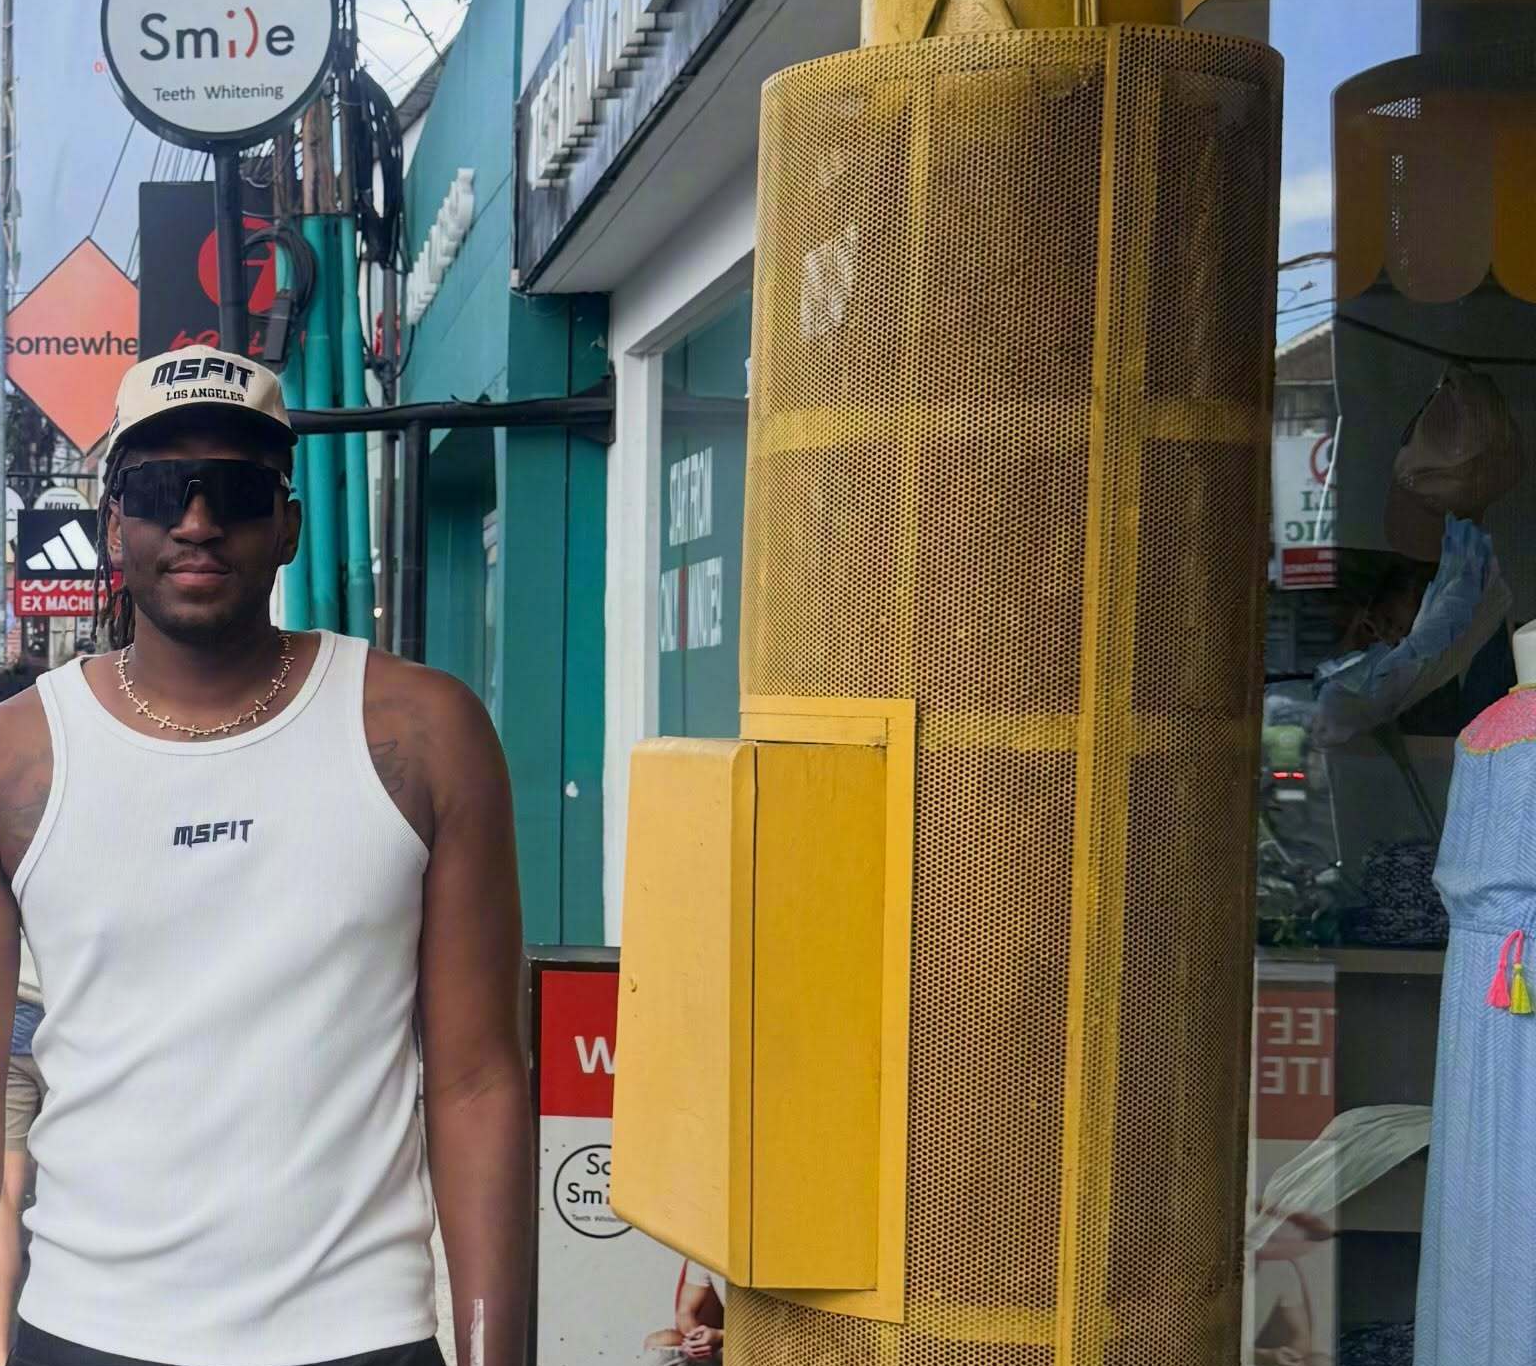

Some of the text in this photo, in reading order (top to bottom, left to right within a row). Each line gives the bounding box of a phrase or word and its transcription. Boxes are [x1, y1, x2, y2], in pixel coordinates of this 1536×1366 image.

[153, 82, 285, 103] Teeth Whitening
[151, 357, 255, 389] MSFIT
[166, 388, 245, 403] LOS ANGELES
[21, 595, 42, 612] EX
[173, 819, 254, 848] MSFIT
